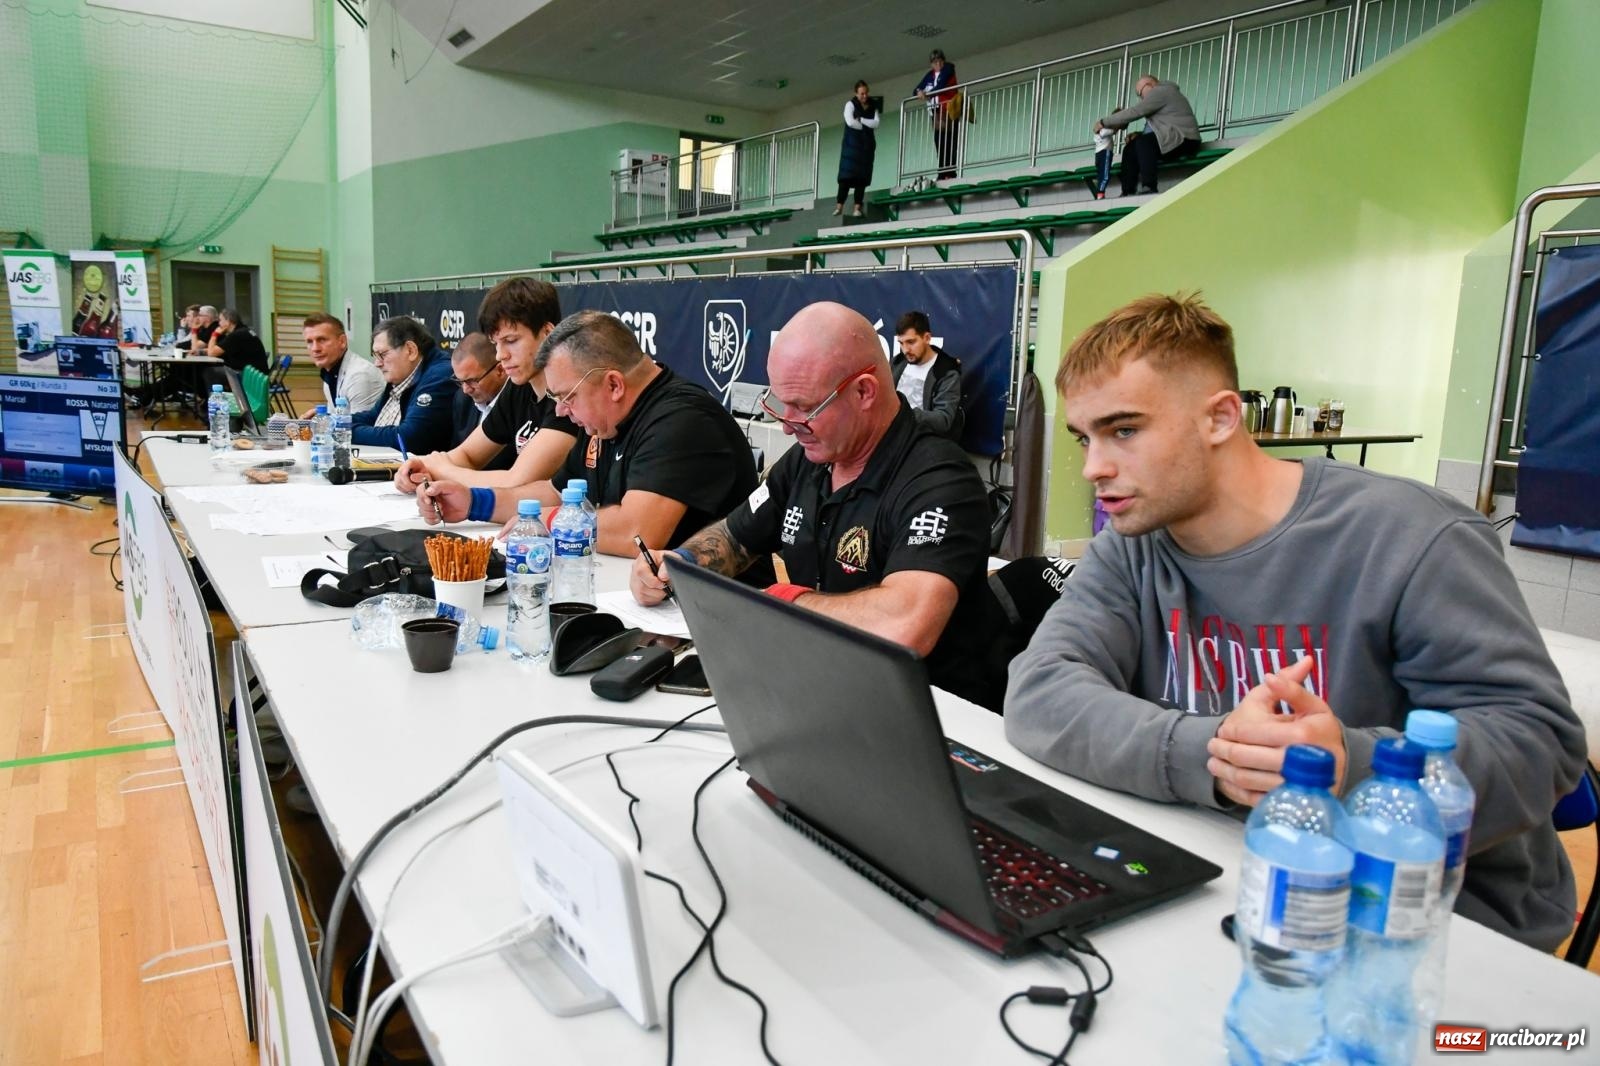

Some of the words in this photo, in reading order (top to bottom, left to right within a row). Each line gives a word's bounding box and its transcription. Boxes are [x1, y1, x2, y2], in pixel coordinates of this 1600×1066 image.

[66, 398, 89, 407] ROSSA
[84, 443, 113, 452] MYSLOW
[557, 541, 583, 551] Saguaro
[1042, 567, 1065, 594] ORLD
